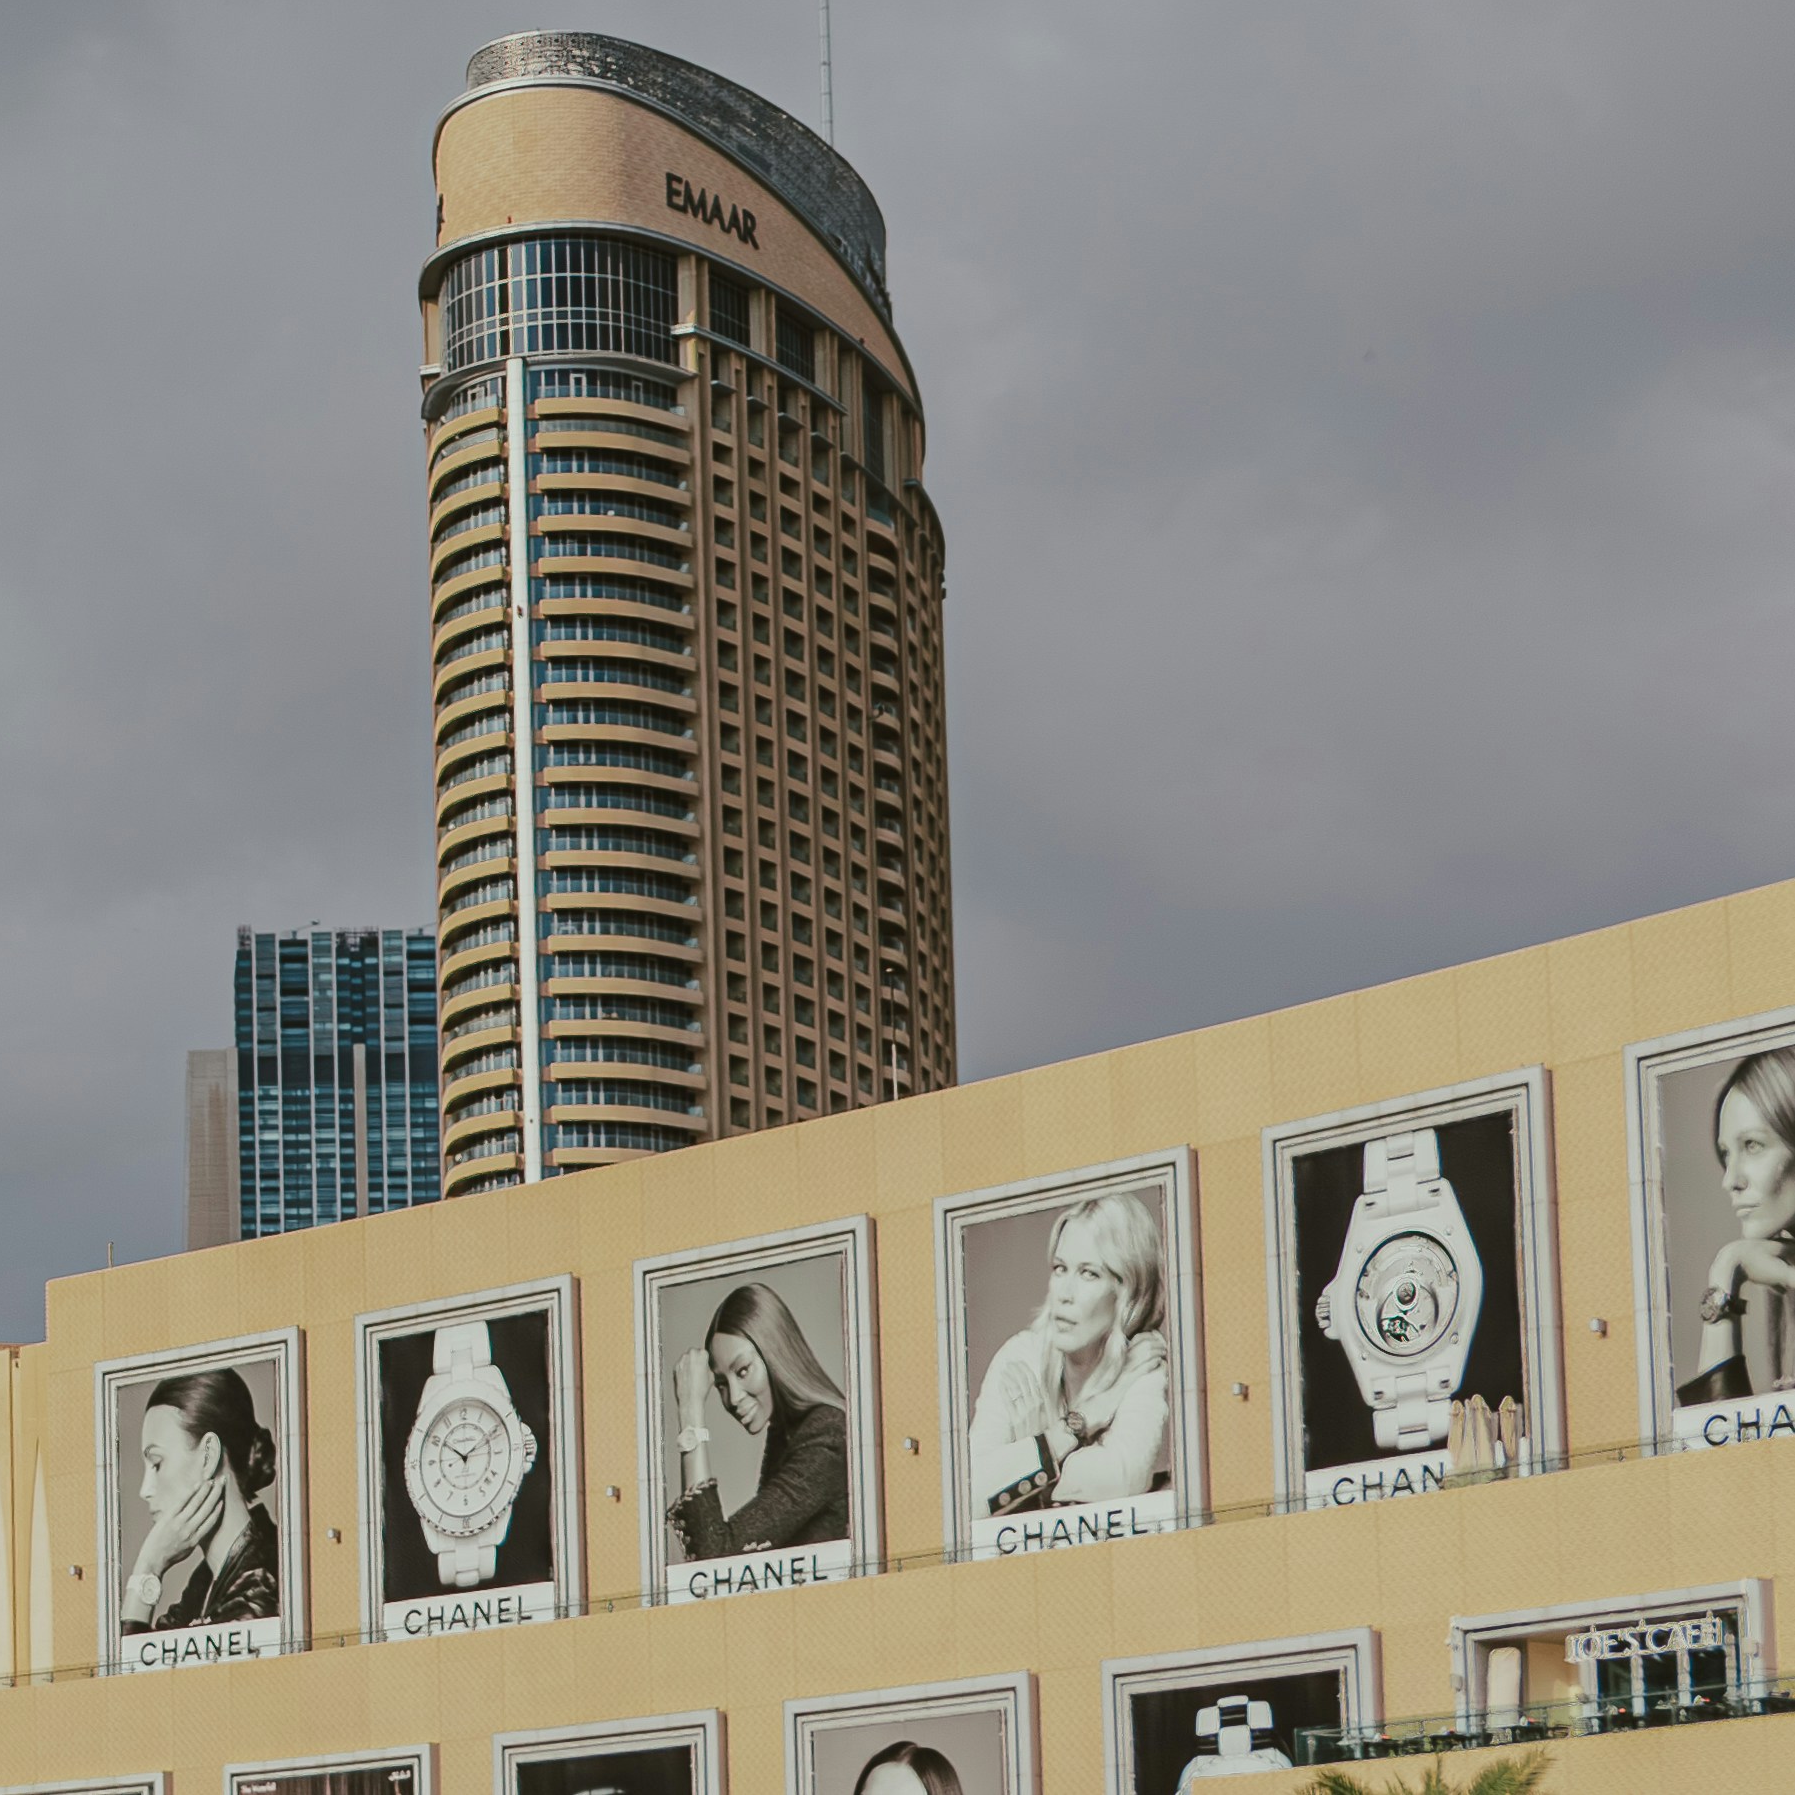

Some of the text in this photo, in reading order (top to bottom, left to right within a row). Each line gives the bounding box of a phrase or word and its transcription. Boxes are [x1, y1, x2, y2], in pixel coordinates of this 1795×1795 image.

[665, 171, 759, 251] EMAAR
[996, 1506, 1149, 1555] CHANEL
[689, 1554, 828, 1599] CHANEL
[404, 1594, 533, 1635] CHANEL
[140, 1629, 259, 1666] CHANEL
